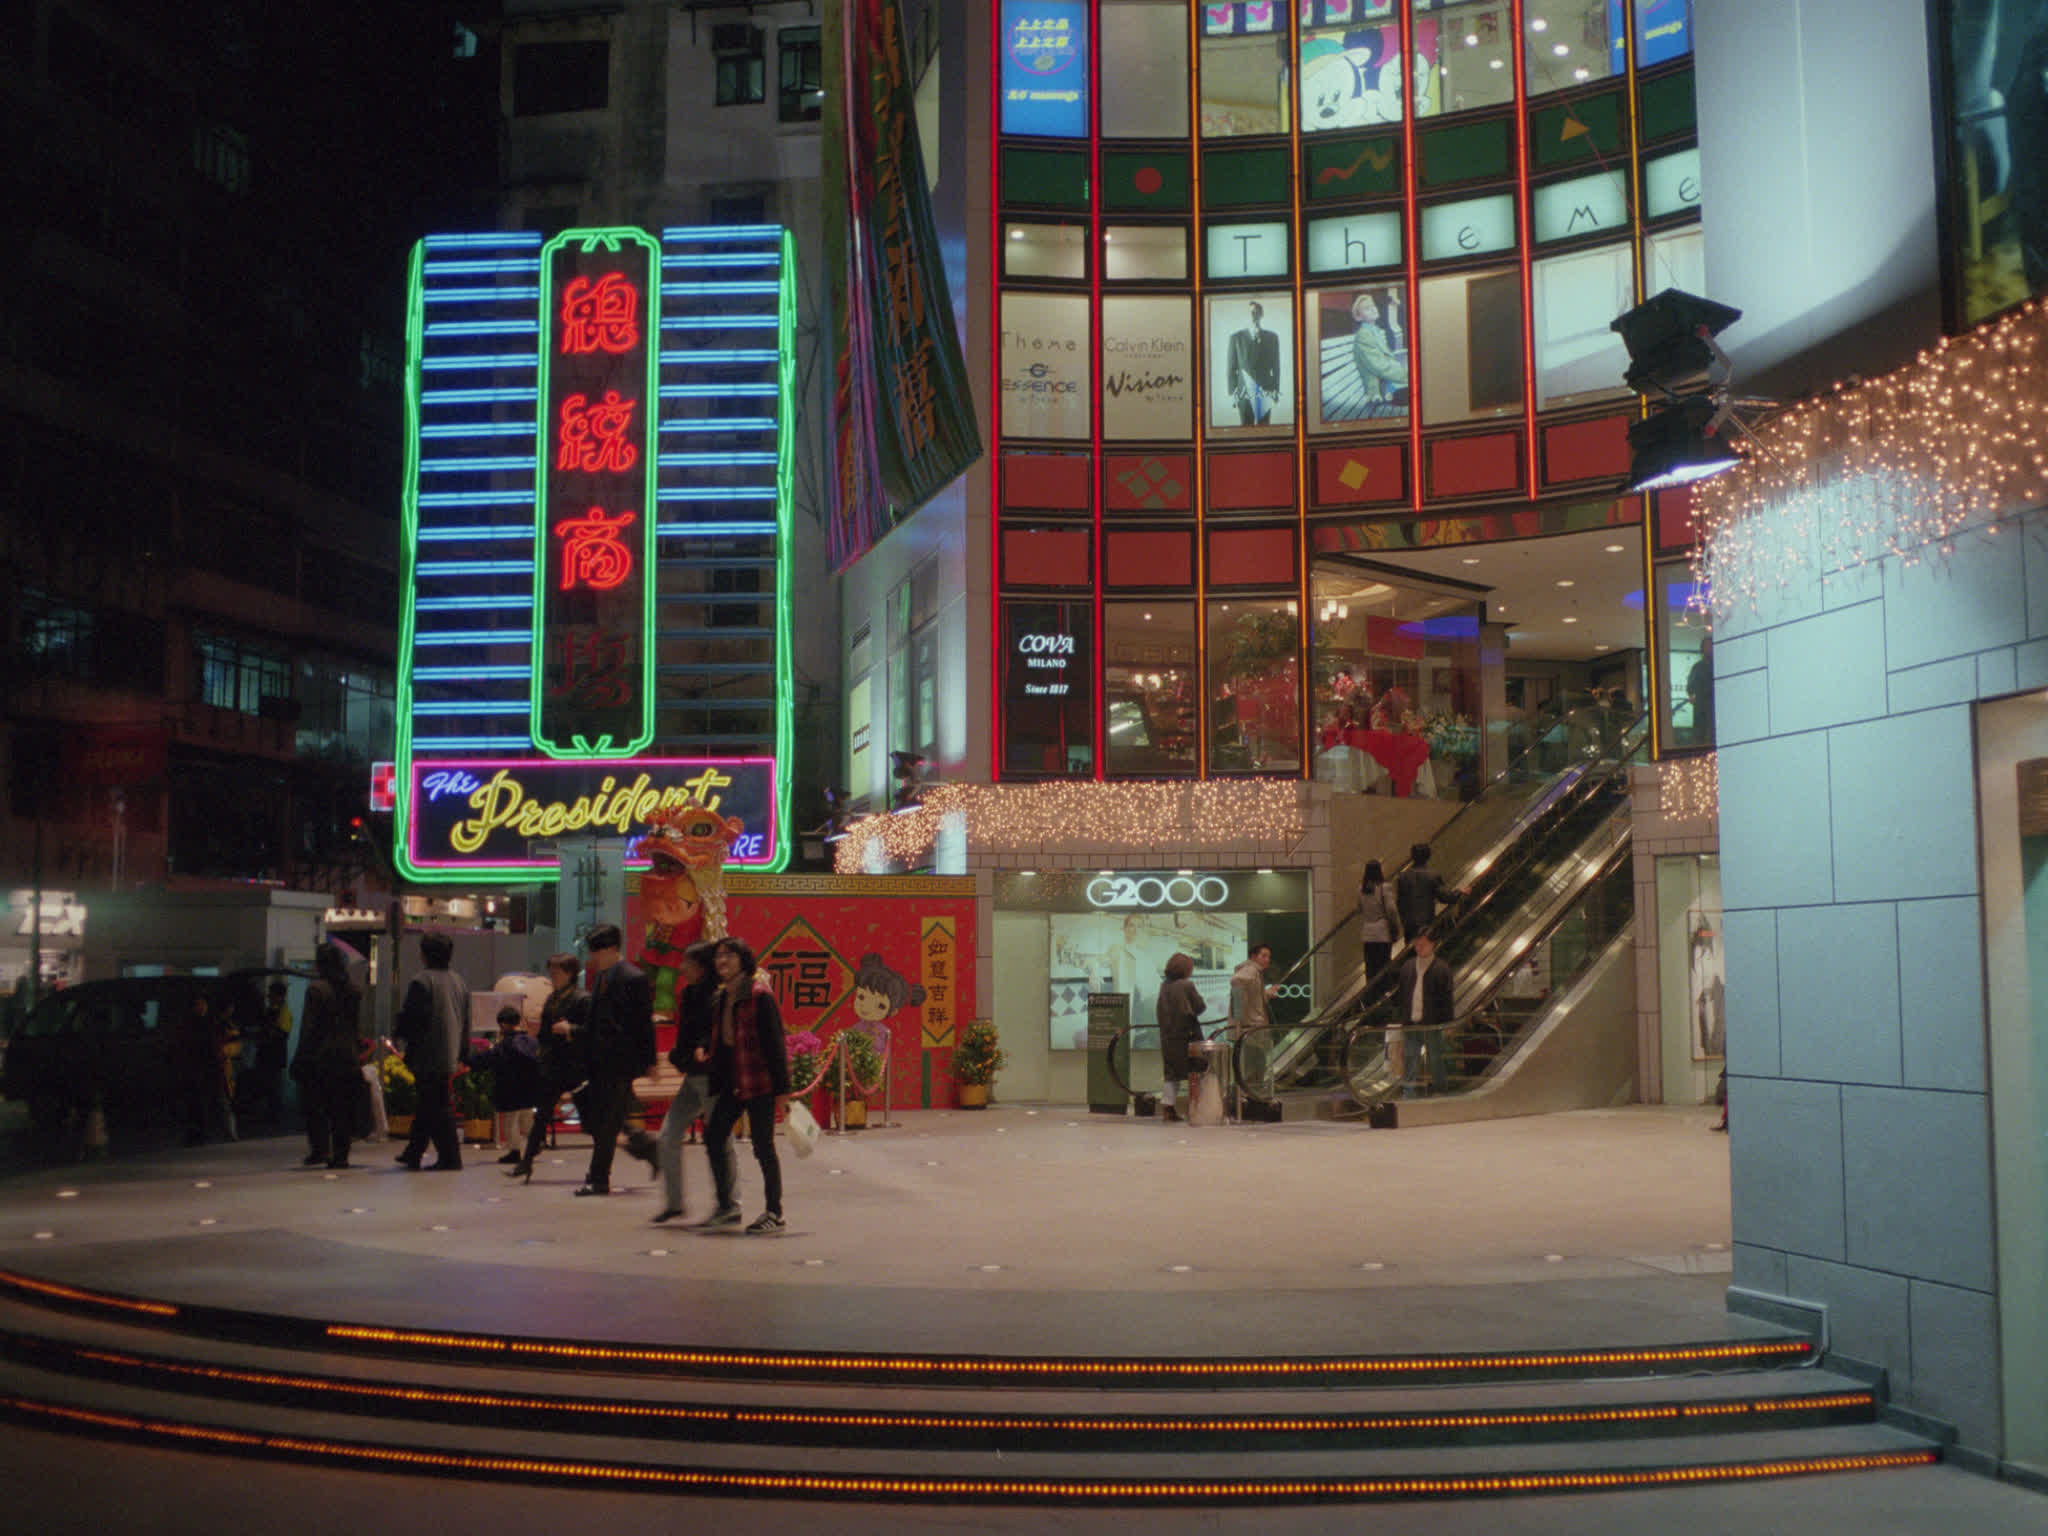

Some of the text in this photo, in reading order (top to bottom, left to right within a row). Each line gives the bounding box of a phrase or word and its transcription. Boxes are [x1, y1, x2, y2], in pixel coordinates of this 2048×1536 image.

[1106, 369, 1184, 399] Vision
[1018, 634, 1075, 653] COVA
[1027, 658, 1067, 668] MILANO
[423, 771, 478, 801] The
[450, 769, 731, 853] President
[1086, 877, 1229, 907] G2000
[768, 951, 831, 1010] 福
